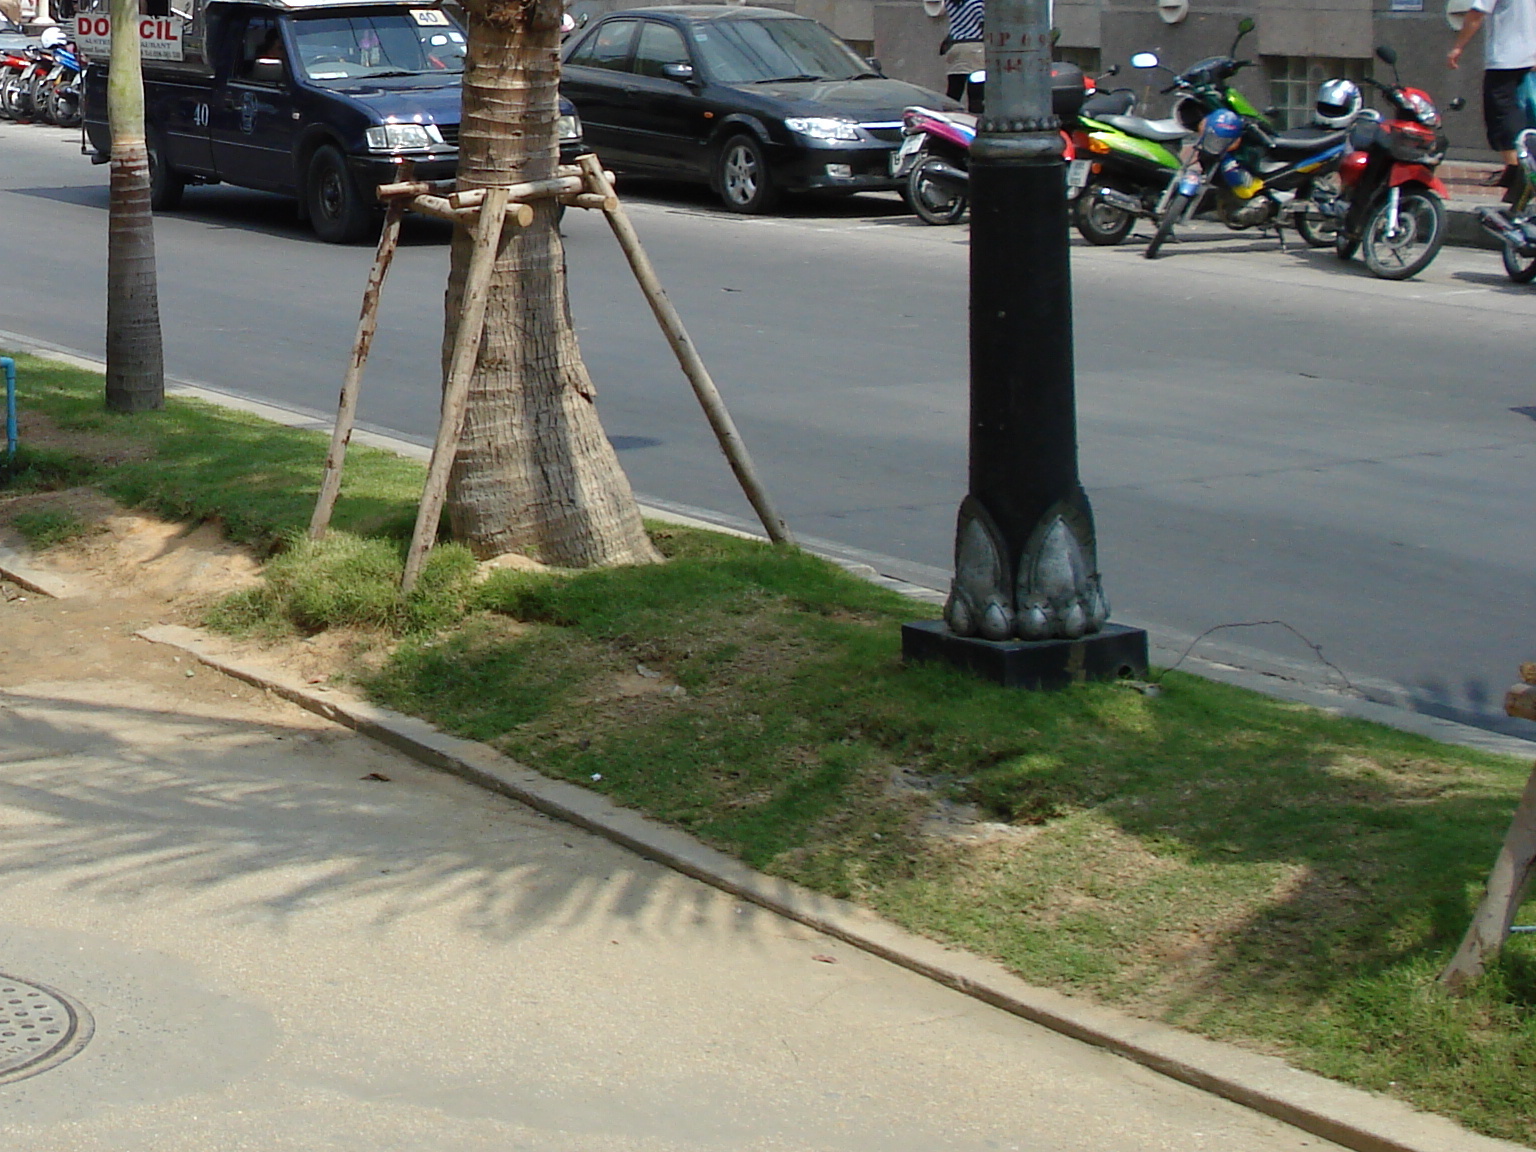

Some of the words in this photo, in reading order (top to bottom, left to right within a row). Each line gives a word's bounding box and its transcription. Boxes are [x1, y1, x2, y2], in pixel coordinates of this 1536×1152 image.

[78, 17, 178, 41] DOCIL
[417, 12, 438, 24] 40
[194, 103, 210, 128] 40
